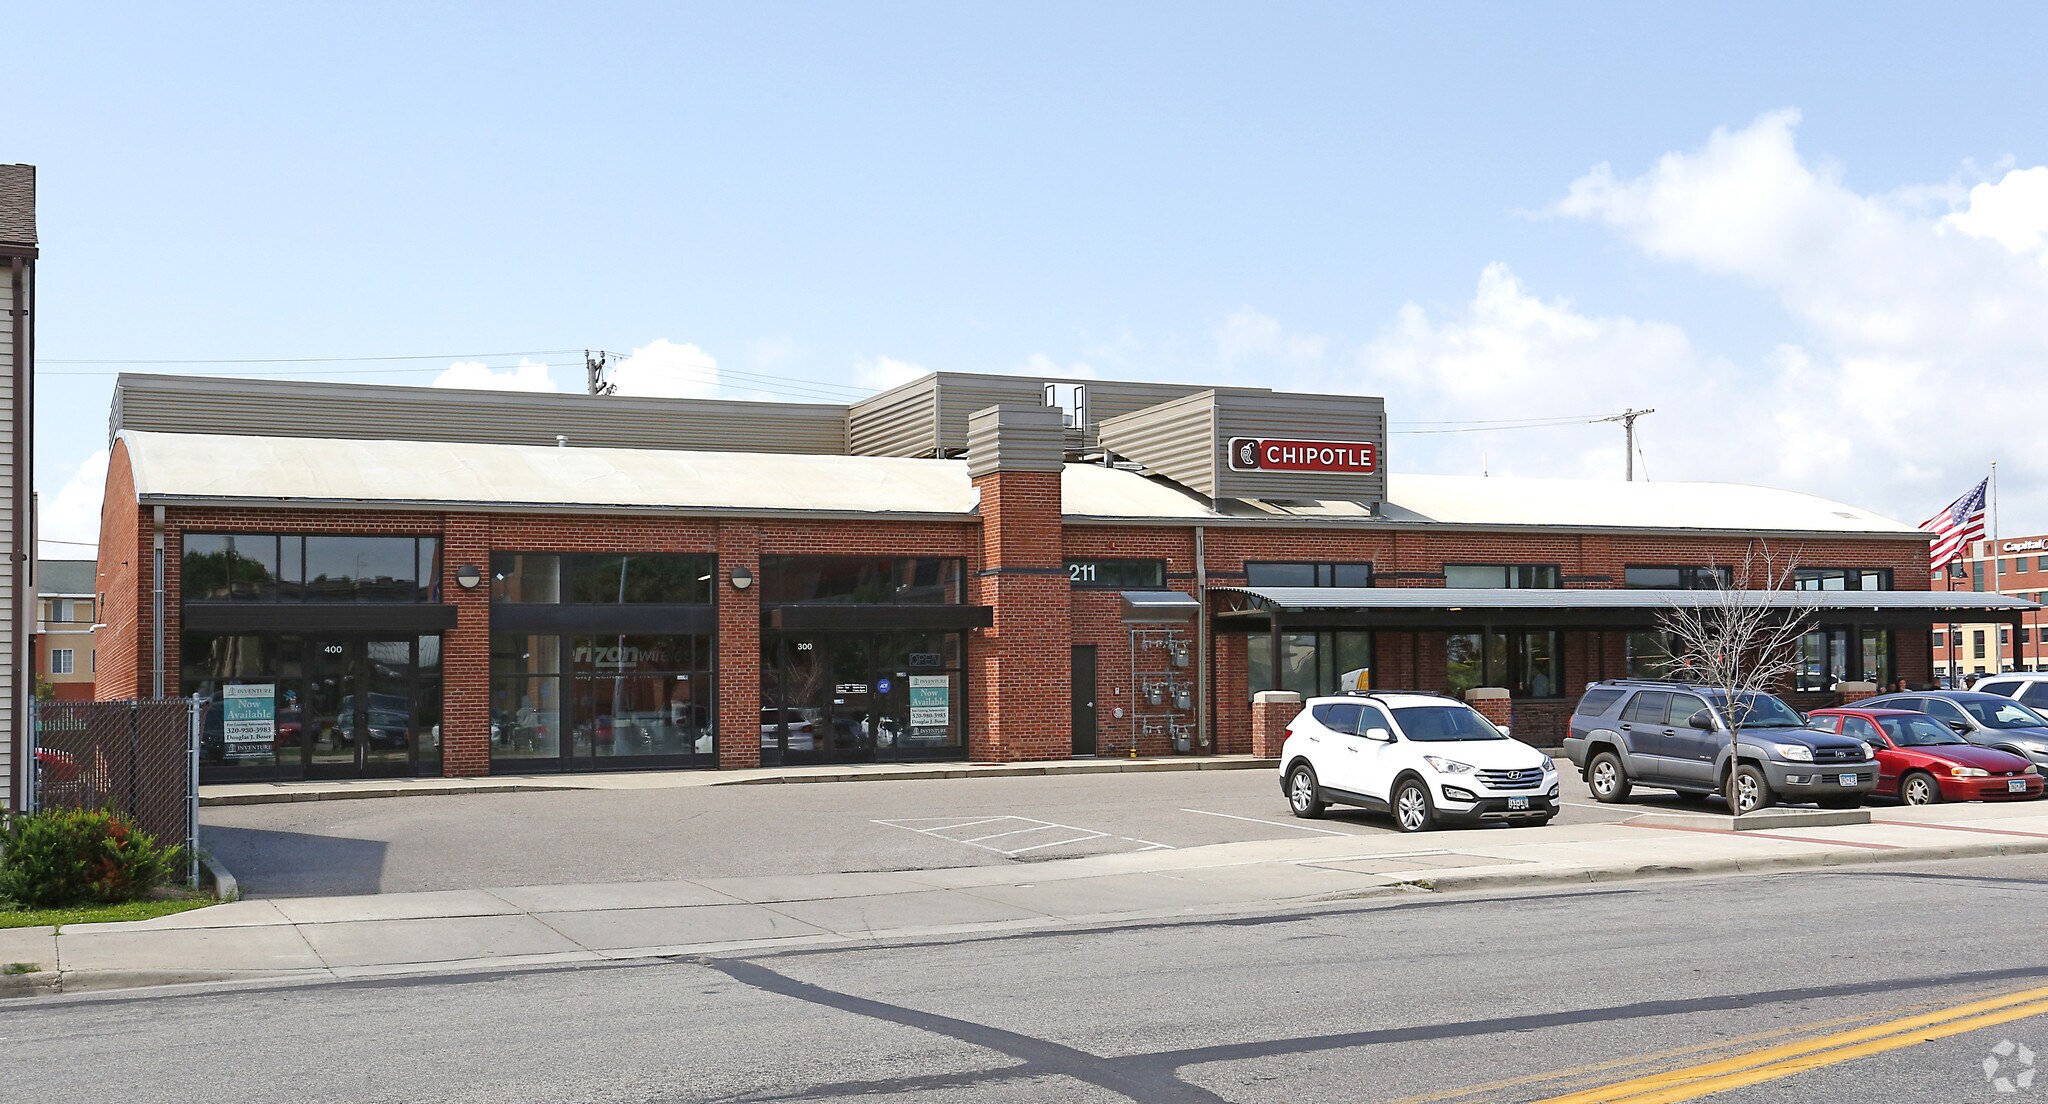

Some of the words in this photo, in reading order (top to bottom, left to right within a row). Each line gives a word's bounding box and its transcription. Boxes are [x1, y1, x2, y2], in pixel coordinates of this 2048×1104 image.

[1266, 446, 1372, 466] CHIPOTLE
[1068, 564, 1096, 581] 211
[324, 645, 343, 654] 400
[797, 643, 813, 651] 300
[920, 689, 939, 697] Now
[238, 700, 260, 708] Now
[912, 698, 946, 706] Available
[227, 709, 271, 719] Available
